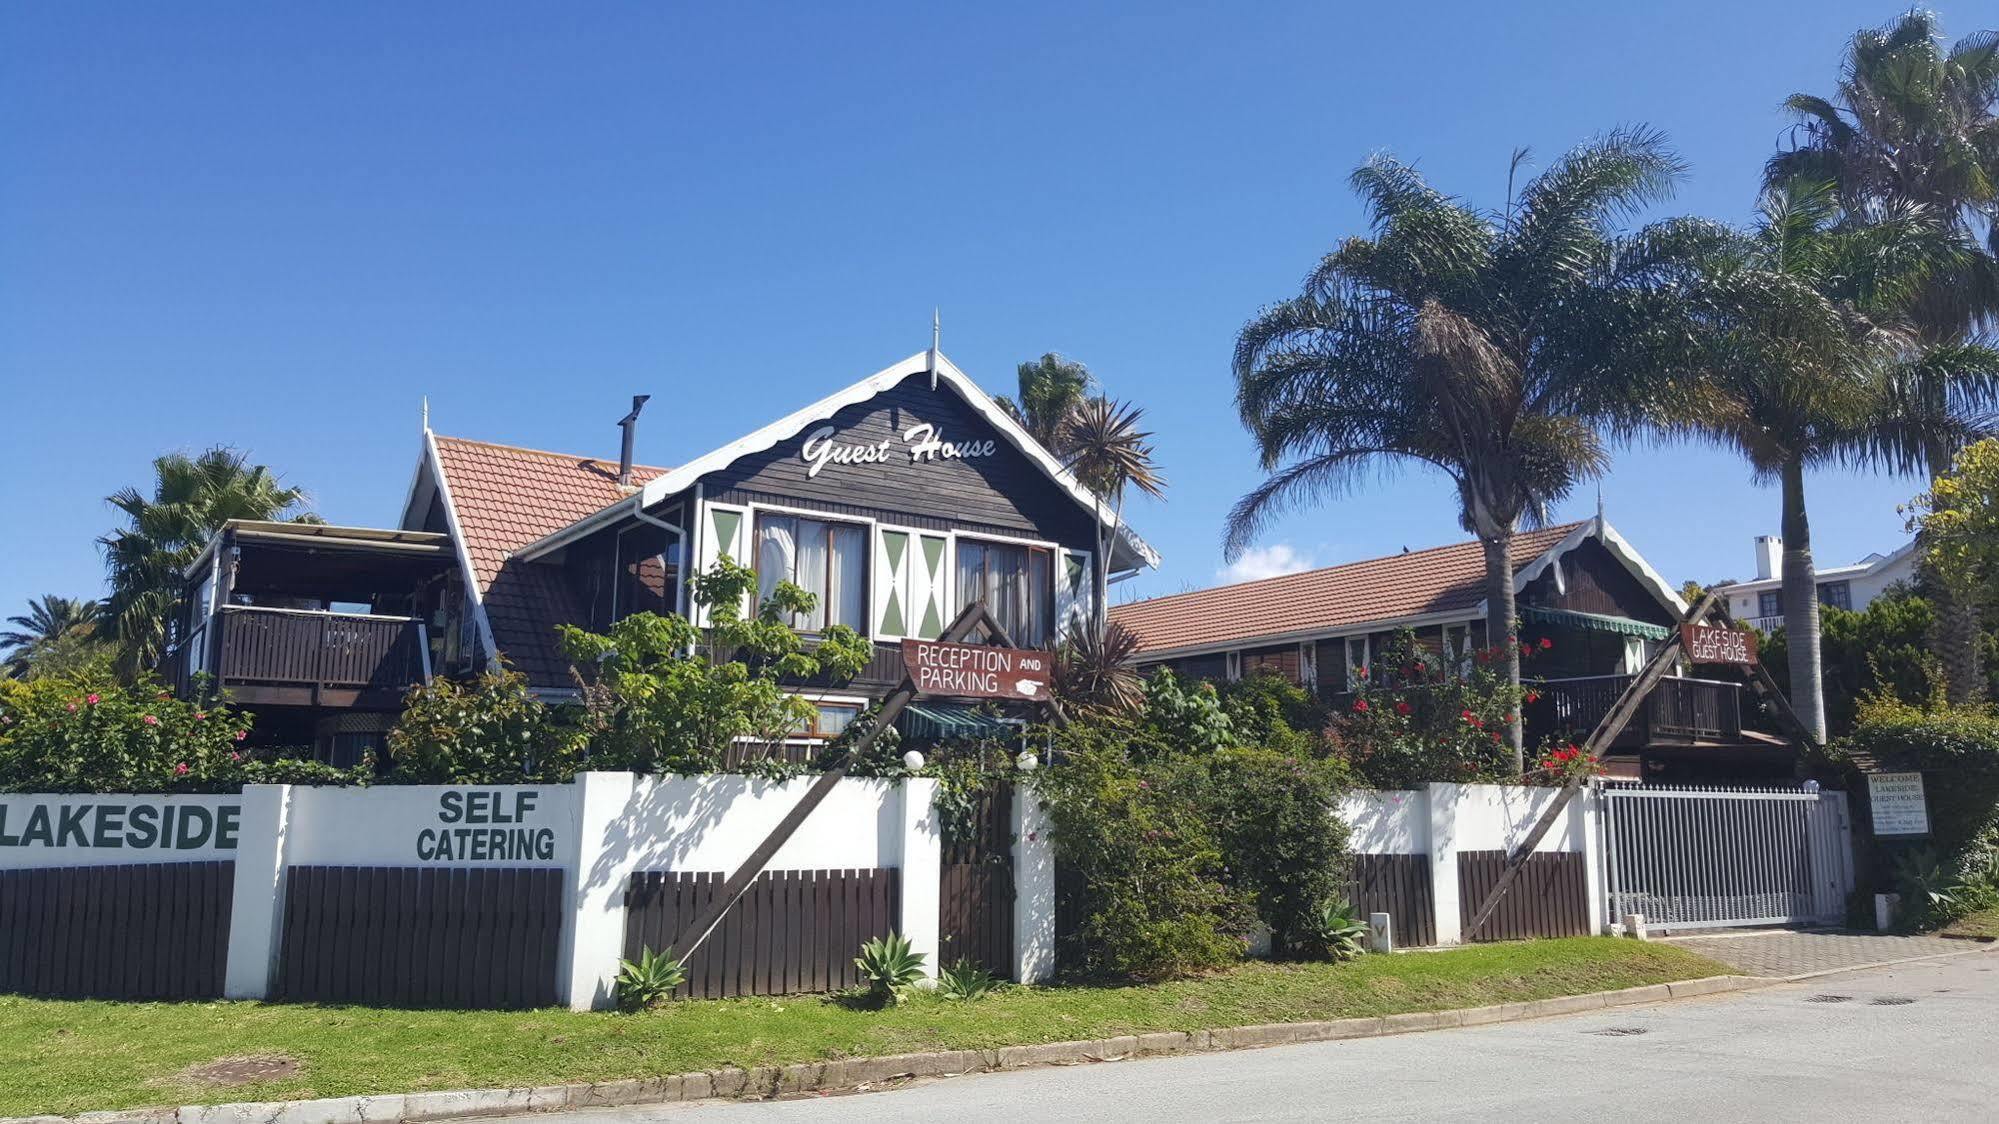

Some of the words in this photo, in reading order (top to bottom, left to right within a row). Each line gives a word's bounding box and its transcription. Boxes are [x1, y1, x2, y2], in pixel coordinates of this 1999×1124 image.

[803, 426, 890, 477] Guest
[903, 423, 995, 460] House
[917, 645, 1011, 672] RECEPTION
[1019, 658, 1042, 671] AND
[1692, 643, 1718, 659] GUEST
[1721, 647, 1749, 662] HOUSE
[920, 667, 998, 692] PARKING
[438, 791, 539, 823] SELF
[0, 804, 241, 849] LAKESIDE
[416, 828, 554, 861] CATERING
